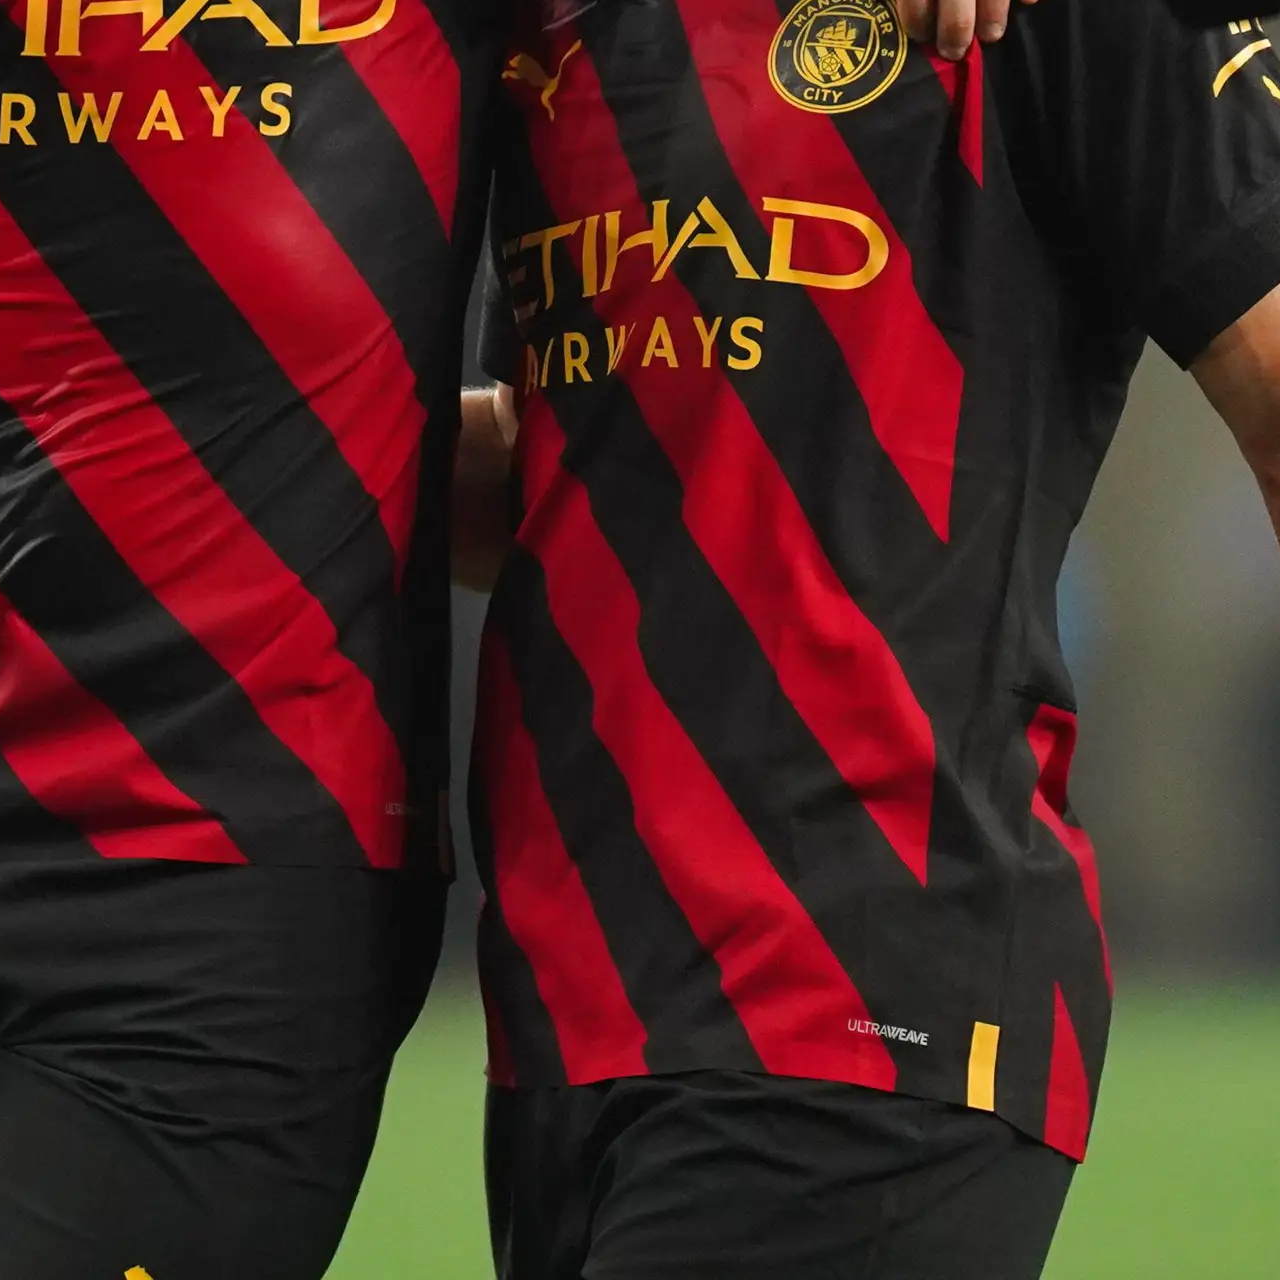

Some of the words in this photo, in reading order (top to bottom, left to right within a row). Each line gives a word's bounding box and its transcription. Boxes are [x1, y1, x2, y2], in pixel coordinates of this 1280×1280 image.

[880, 48, 895, 58] 94
[803, 87, 843, 103] CITY
[847, 1019, 929, 1046] ULTRAWEAVE
